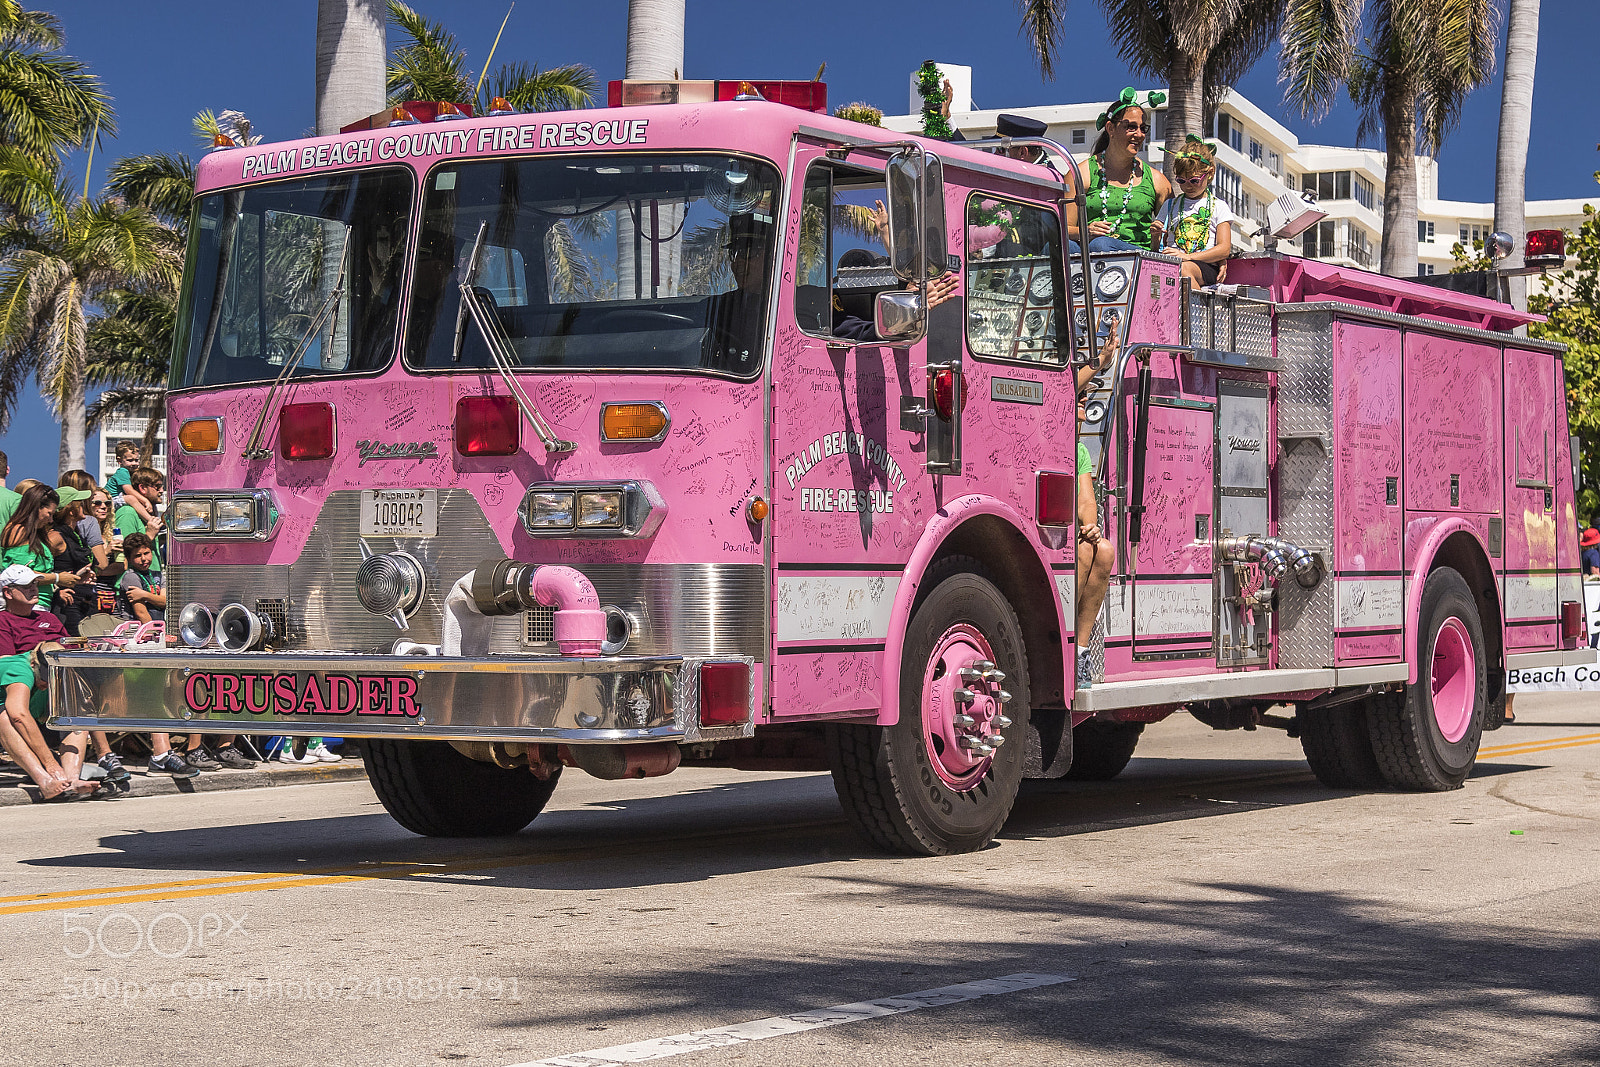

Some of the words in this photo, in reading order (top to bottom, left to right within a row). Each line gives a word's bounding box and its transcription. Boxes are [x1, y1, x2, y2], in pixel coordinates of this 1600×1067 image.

[242, 149, 298, 179] PALM
[300, 139, 375, 170] BEACH
[378, 129, 475, 161] COUNTY
[477, 125, 536, 152] FIRE
[540, 119, 649, 148] RESCUE
[995, 383, 1033, 398] CRUSADER
[1034, 388, 1039, 399] II
[355, 439, 439, 469] Young
[1227, 434, 1261, 456] Young
[785, 439, 822, 491] PALM
[823, 431, 865, 458] BEACH
[866, 438, 908, 493] COUNTY
[381, 491, 416, 500] FLORIDA
[800, 487, 894, 513] FIRE-RESCUE
[373, 503, 424, 526] 108042
[383, 527, 413, 535] COUNTY
[1508, 667, 1566, 685] Beach
[183, 672, 422, 718] CRUSADER
